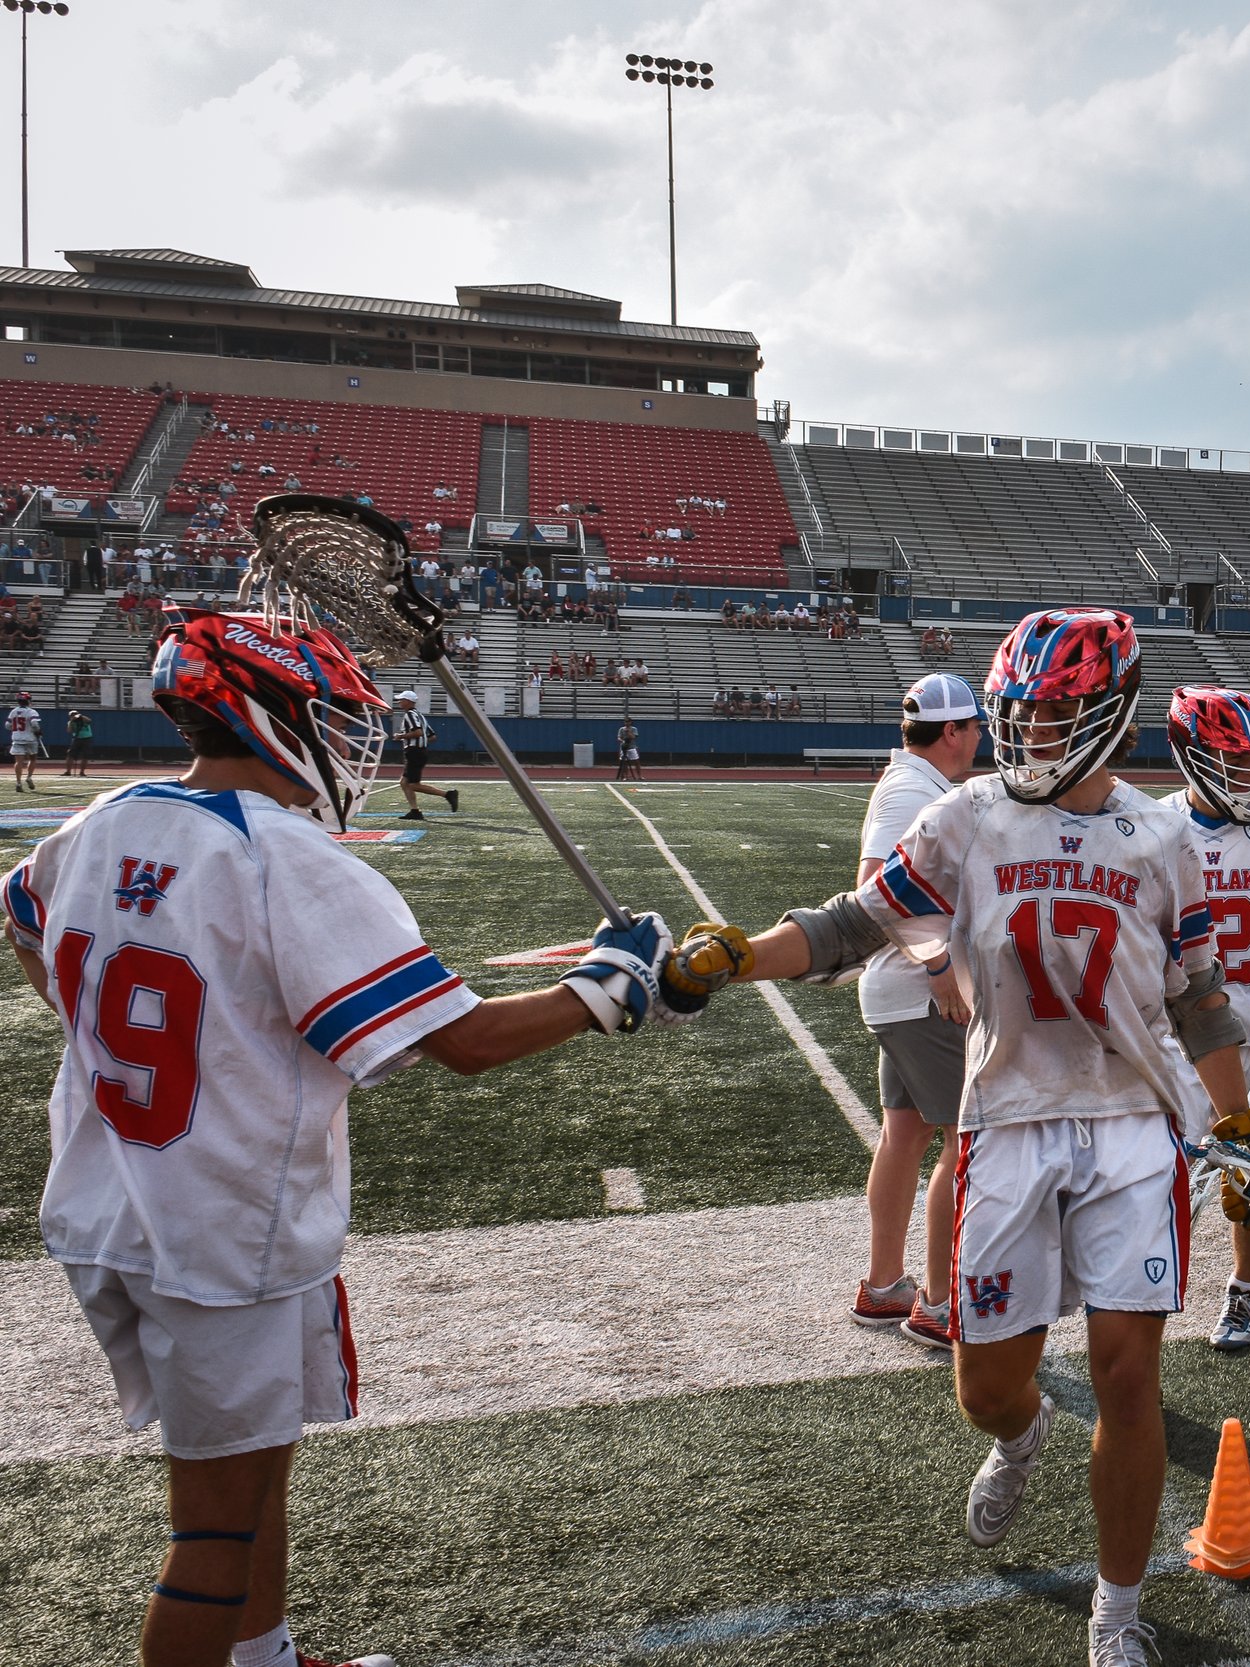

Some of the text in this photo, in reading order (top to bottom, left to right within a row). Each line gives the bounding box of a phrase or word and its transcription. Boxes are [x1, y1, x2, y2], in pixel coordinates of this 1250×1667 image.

[224, 623, 315, 681] Westlake
[994, 858, 1141, 908] WESTLAKE
[1005, 897, 1121, 1031] 17
[53, 926, 207, 1151] 19
